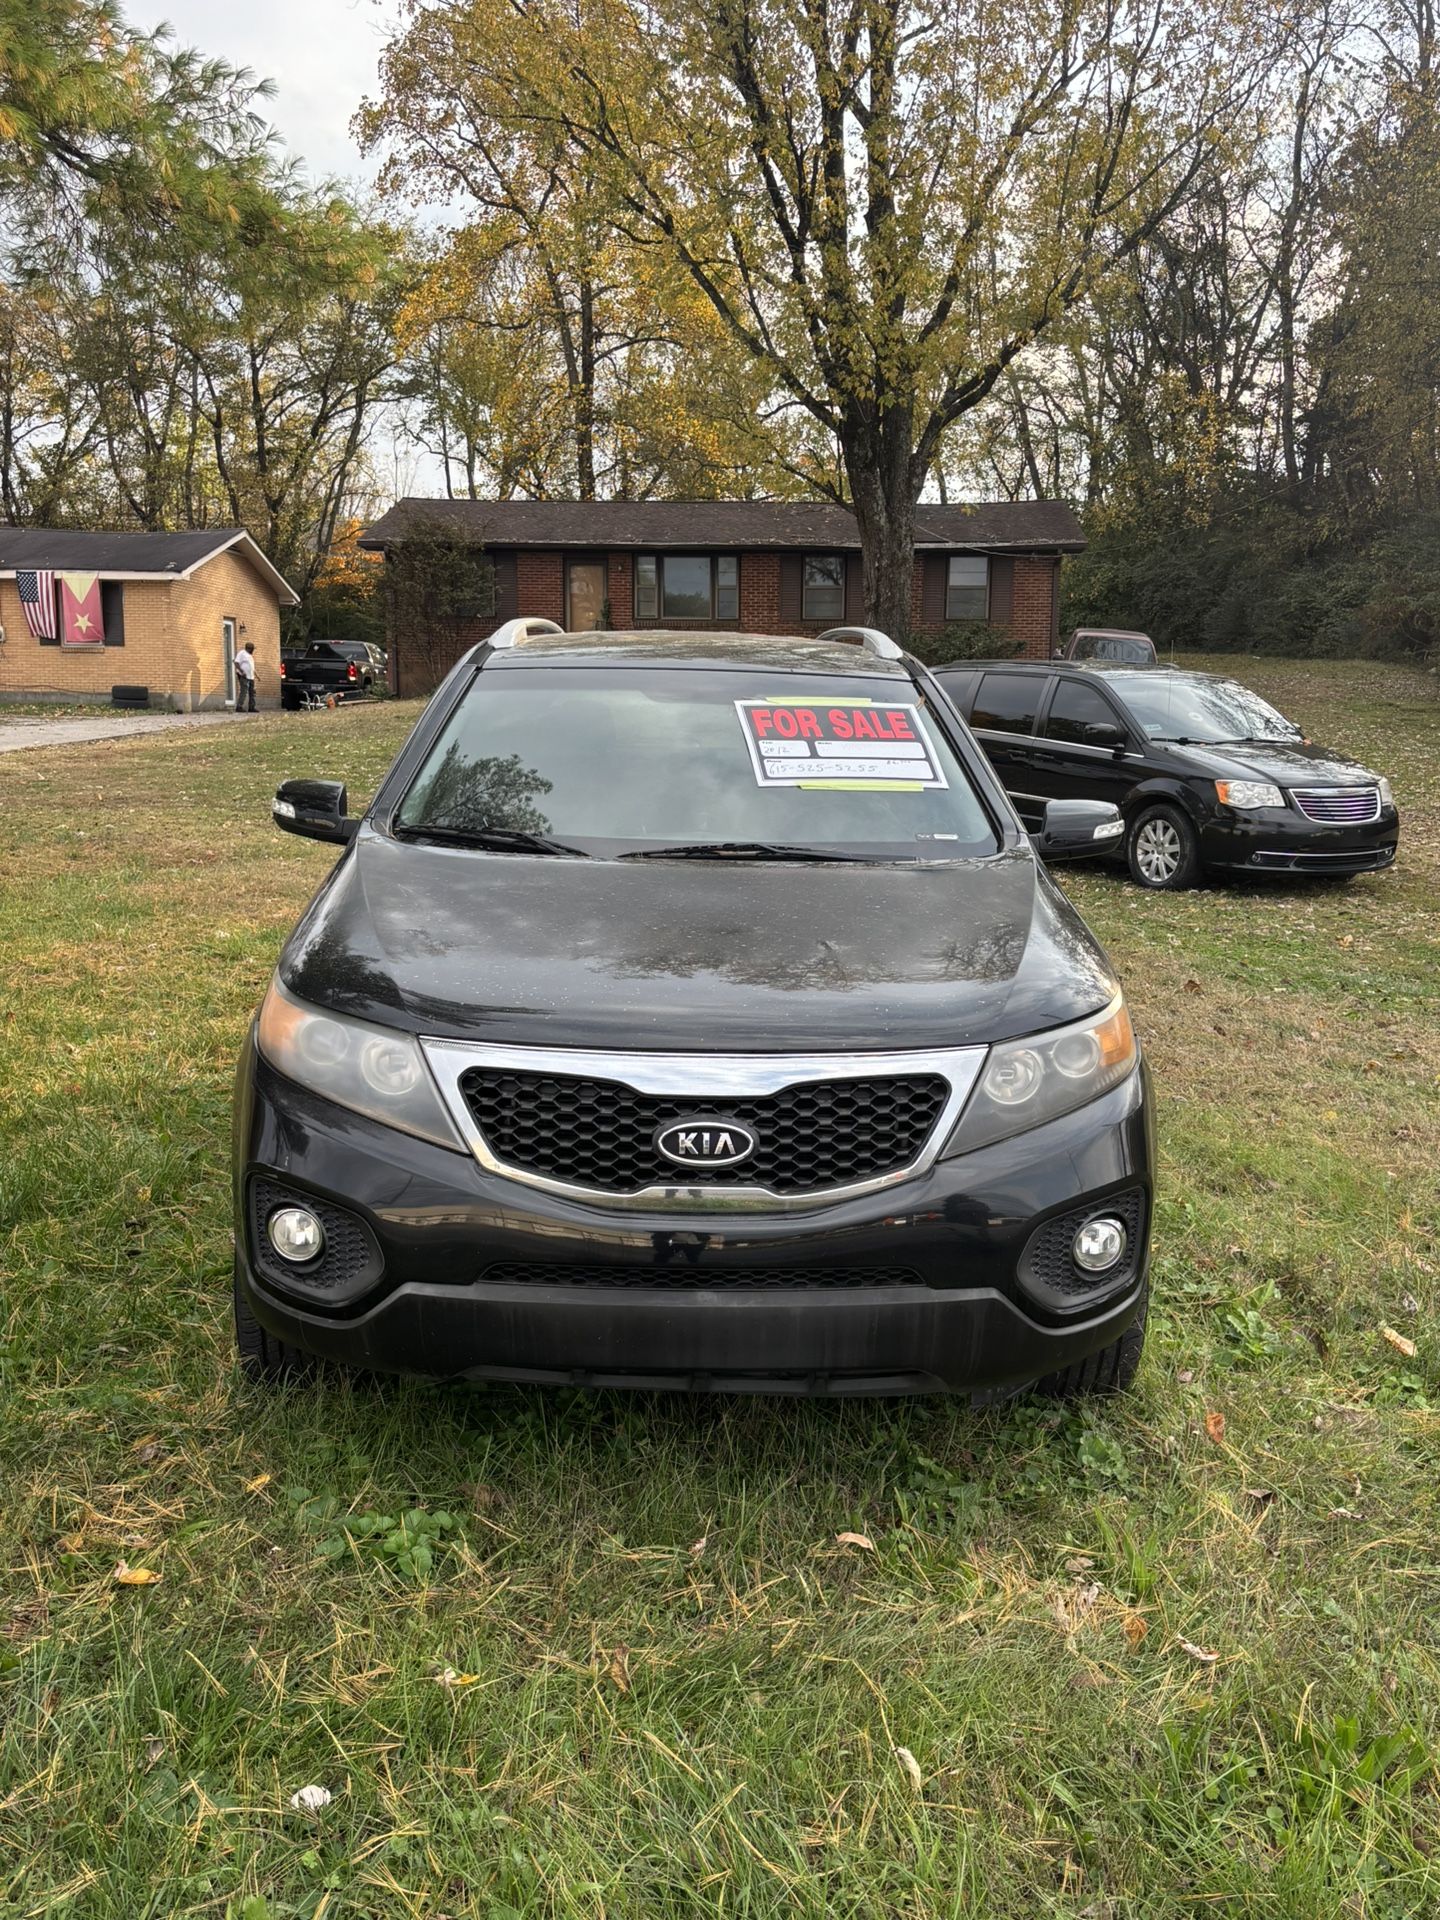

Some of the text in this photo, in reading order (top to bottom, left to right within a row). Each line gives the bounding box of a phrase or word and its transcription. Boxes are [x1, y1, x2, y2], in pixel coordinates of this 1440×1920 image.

[752, 709, 915, 739] FOR SALE
[677, 1132, 736, 1155] KIA
